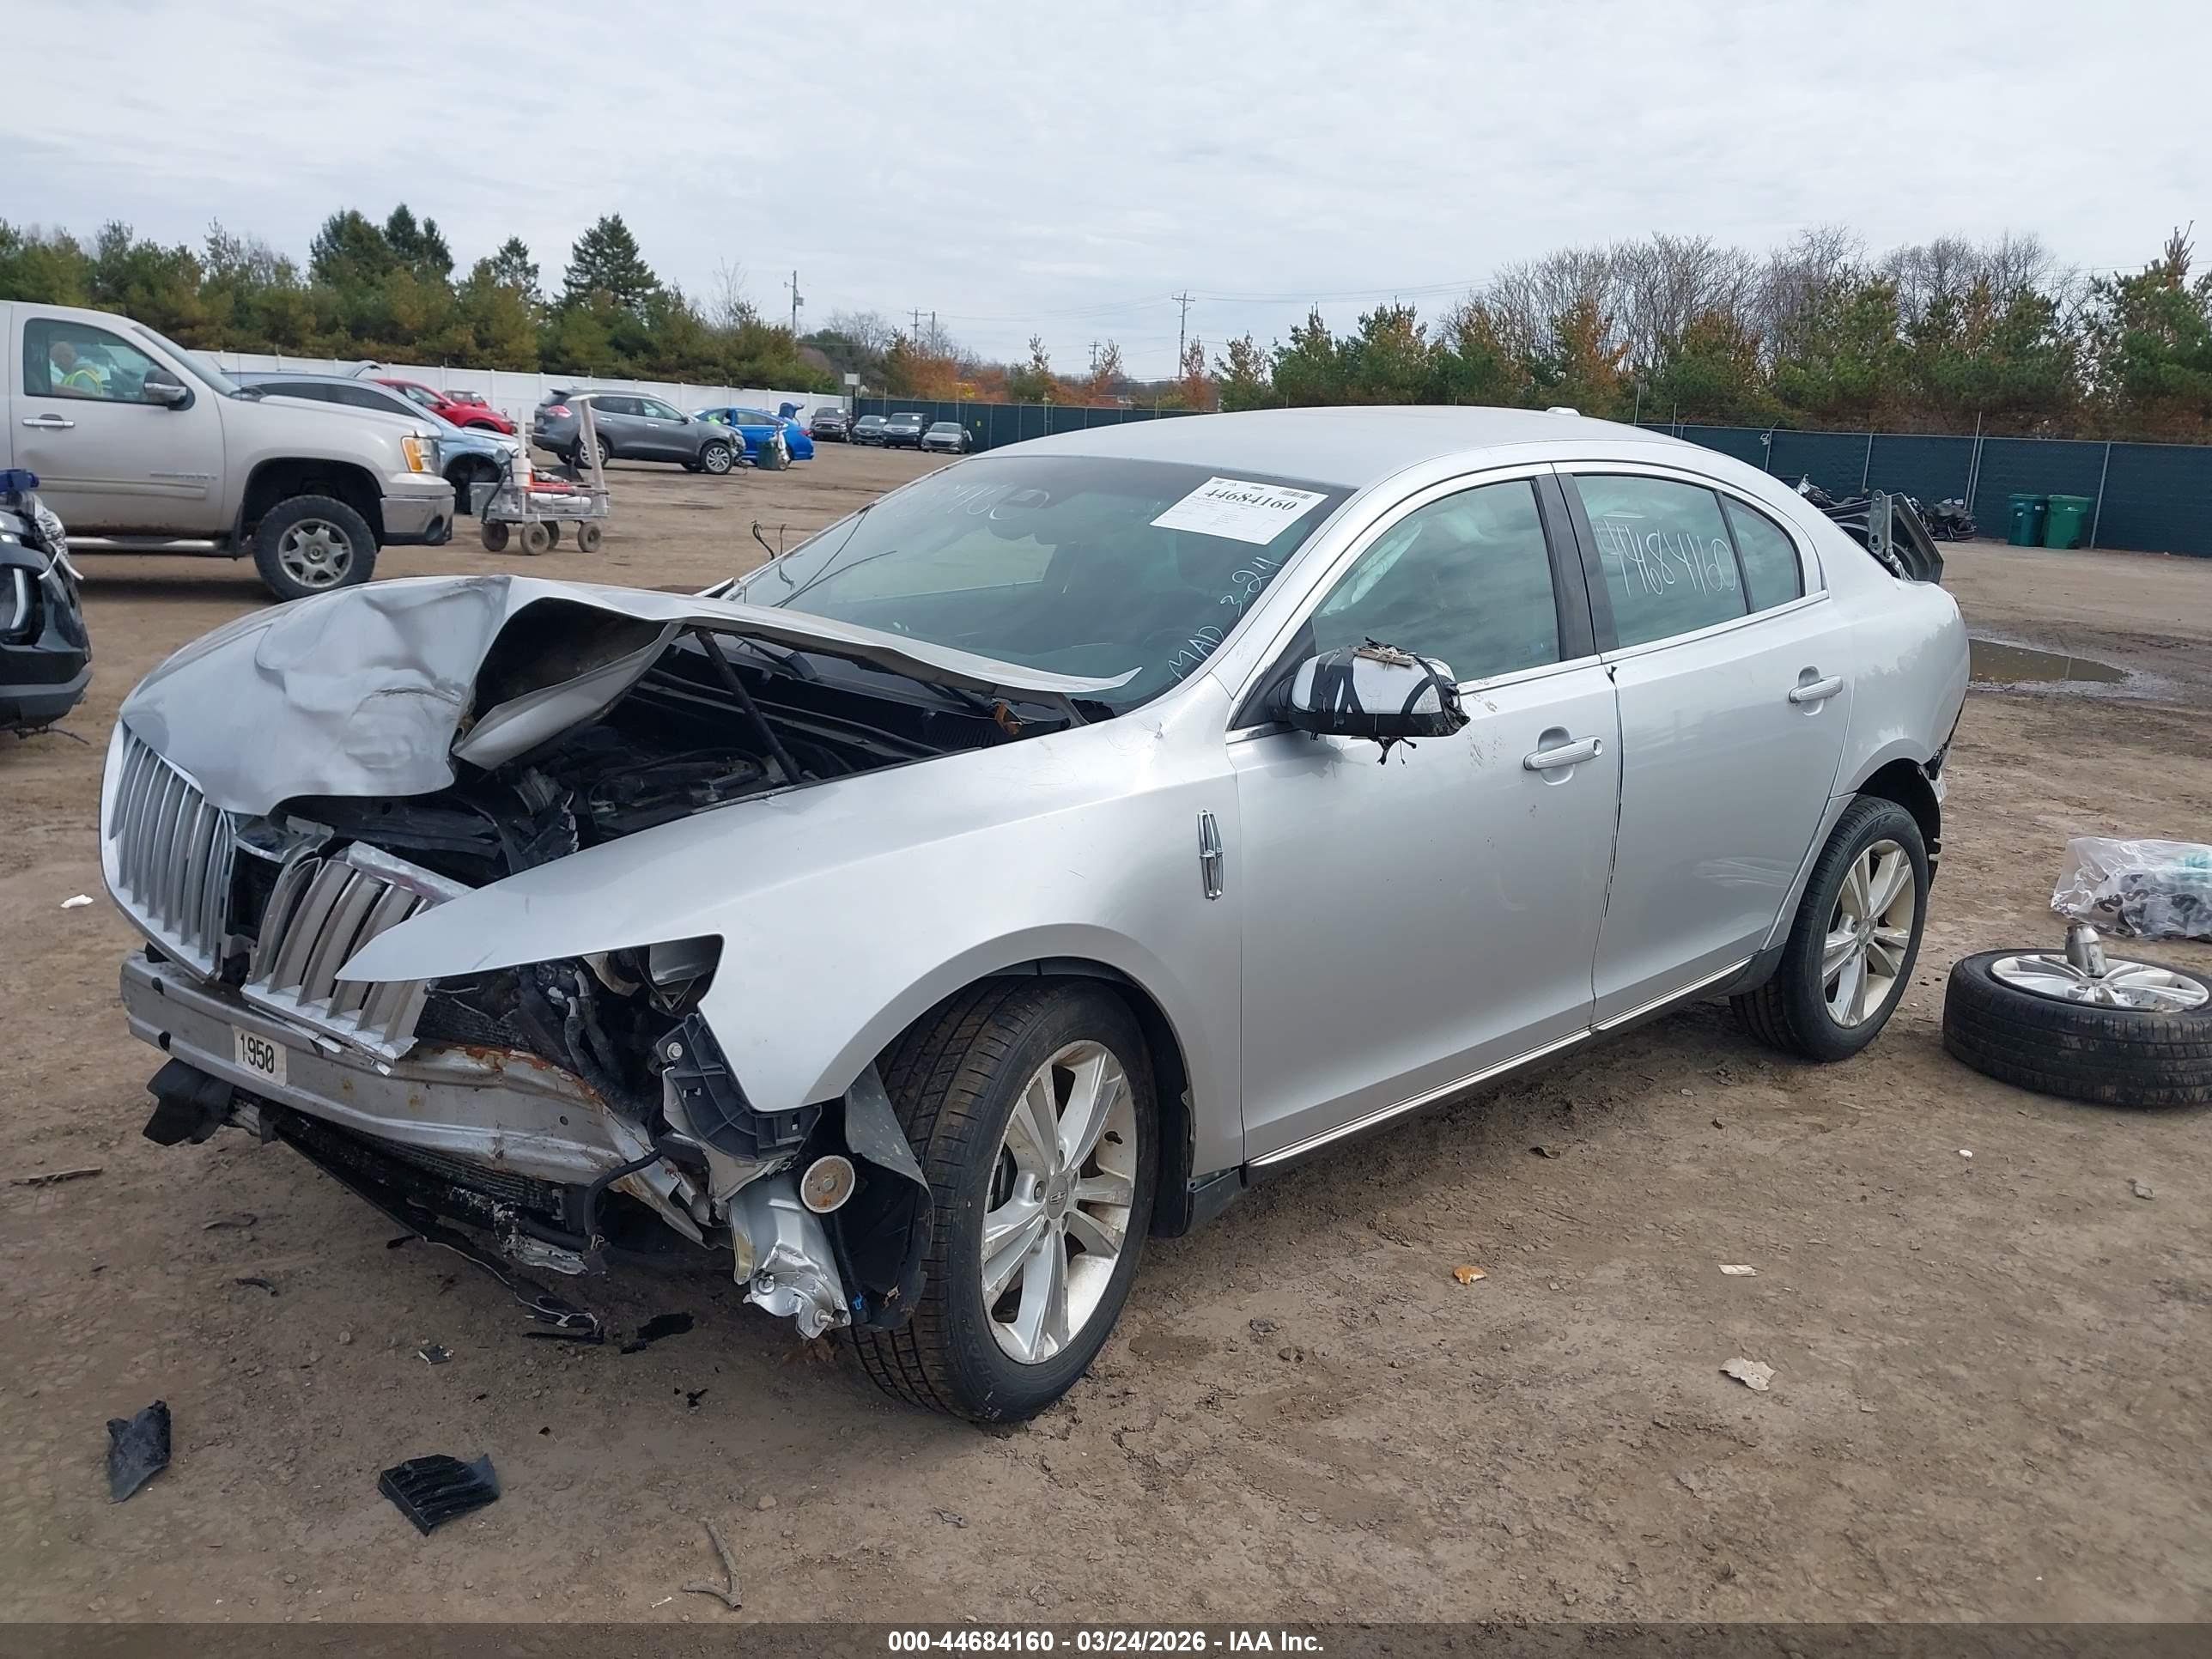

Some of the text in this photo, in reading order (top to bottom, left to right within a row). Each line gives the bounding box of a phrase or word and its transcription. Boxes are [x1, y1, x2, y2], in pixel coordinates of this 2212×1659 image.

[1204, 489, 1298, 512] 44684160
[1168, 625, 1225, 680] MAD
[240, 1033, 275, 1074] 1950
